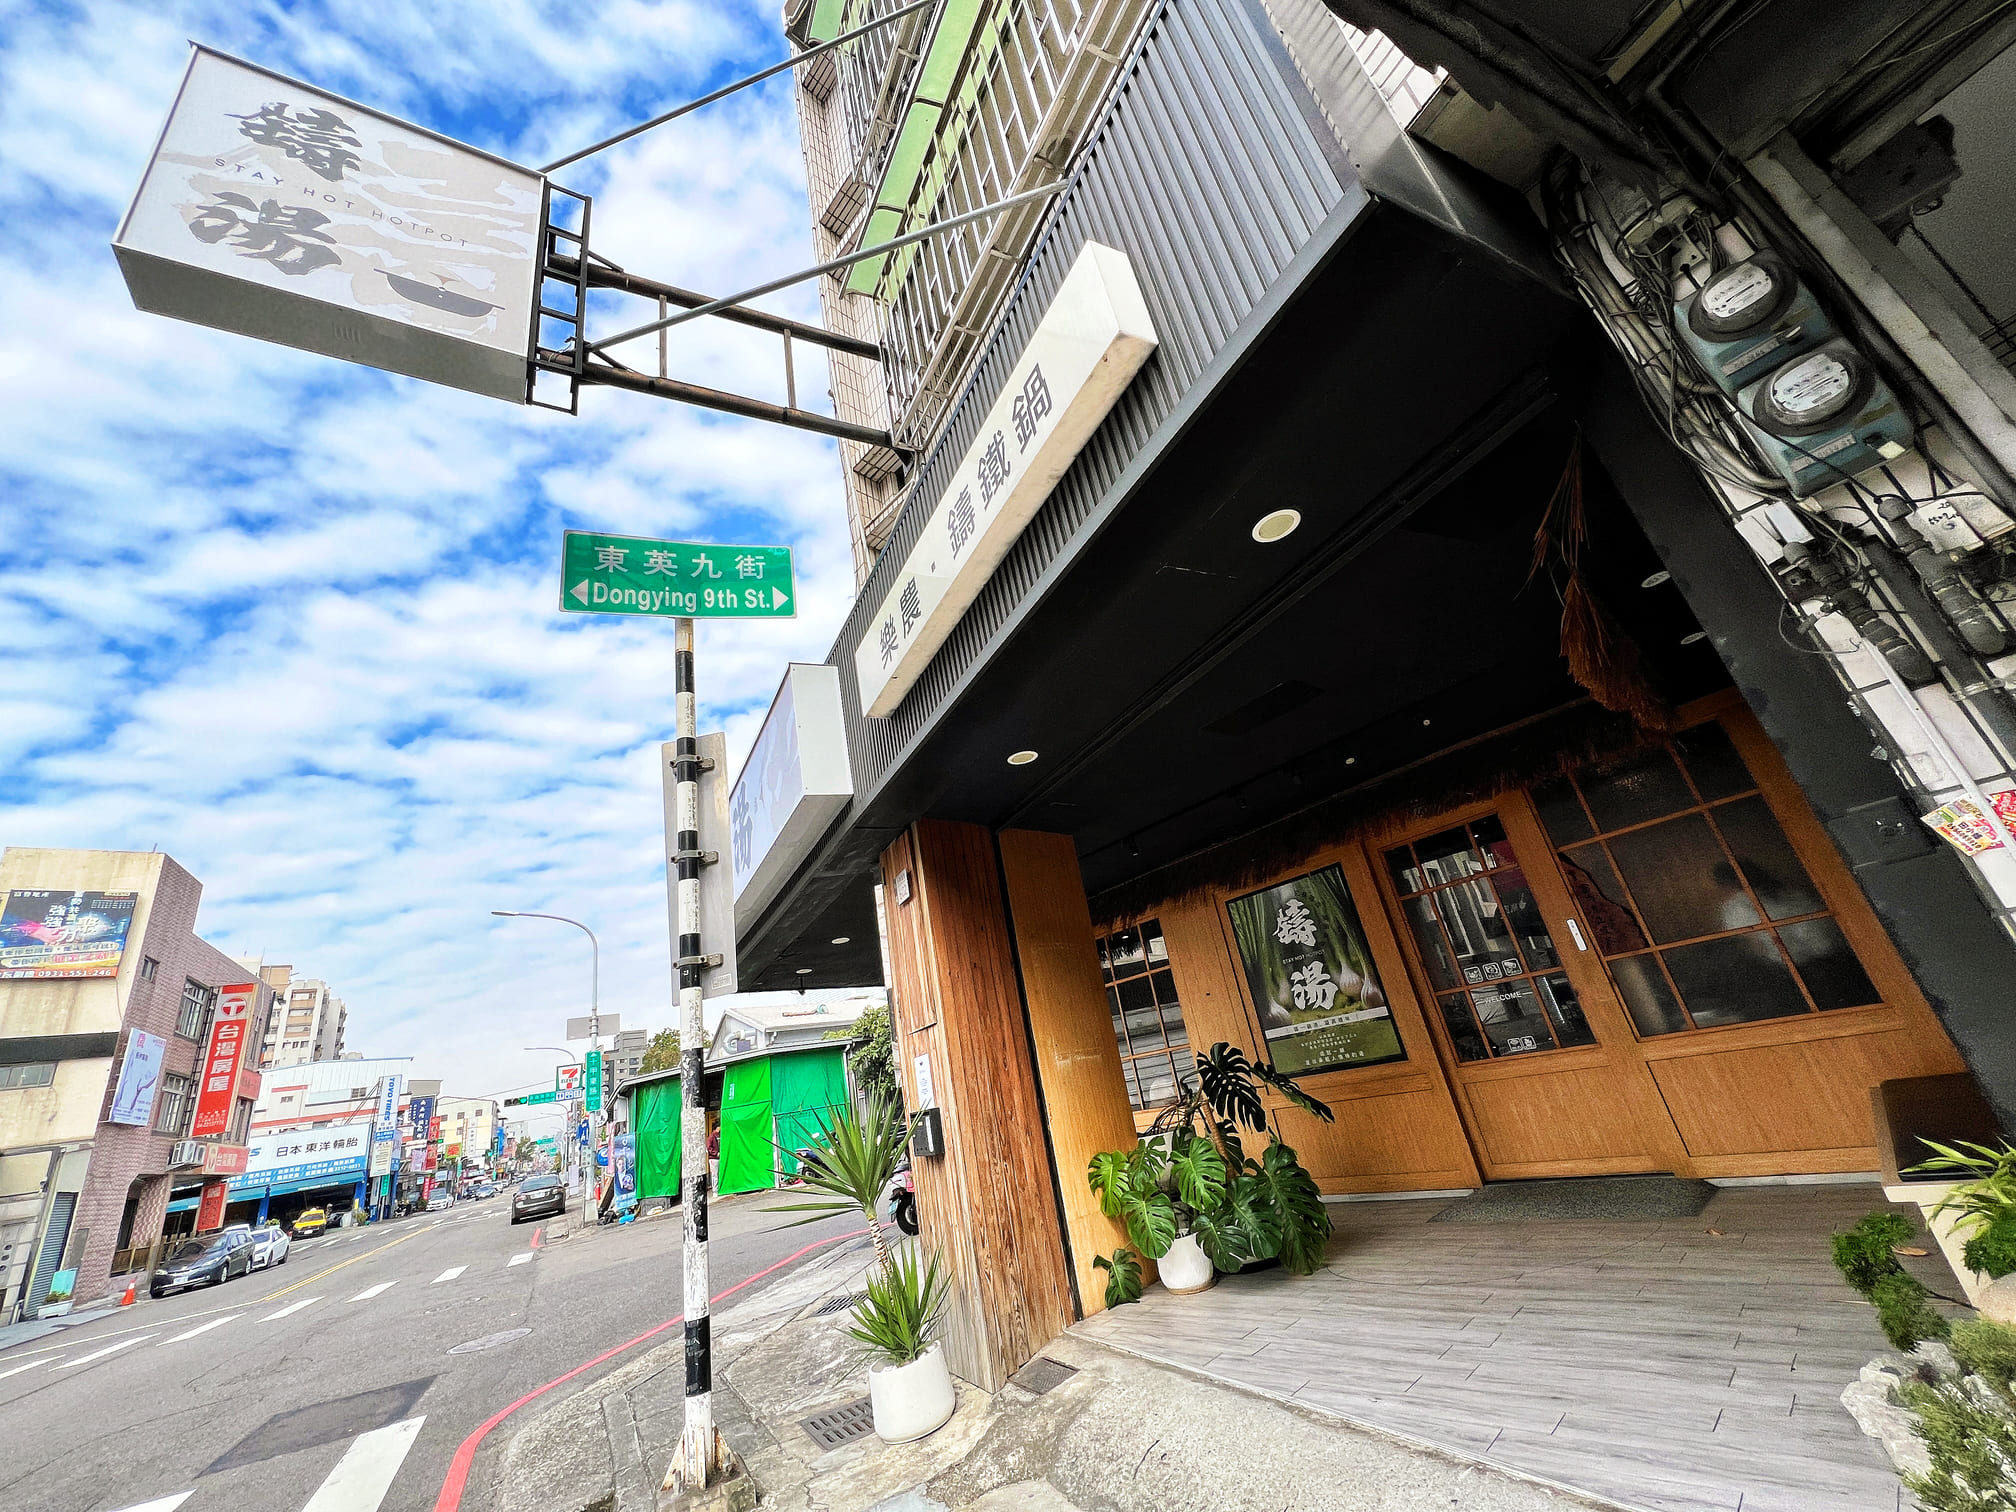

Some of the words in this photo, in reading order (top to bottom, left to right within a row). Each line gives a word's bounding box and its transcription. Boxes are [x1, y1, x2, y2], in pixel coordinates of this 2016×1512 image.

[215, 158, 284, 185] STAY
[303, 187, 354, 209] HOT
[372, 209, 468, 248] HOTPOT
[593, 545, 766, 580] 東英九街
[593, 582, 697, 613] Dongying
[704, 588, 738, 609] 9th
[744, 588, 770, 609] St.
[1485, 991, 1522, 1003] WELCOME
[206, 1024, 240, 1093] 台灣房屋
[276, 1136, 359, 1157] 日本東洋輪胎
